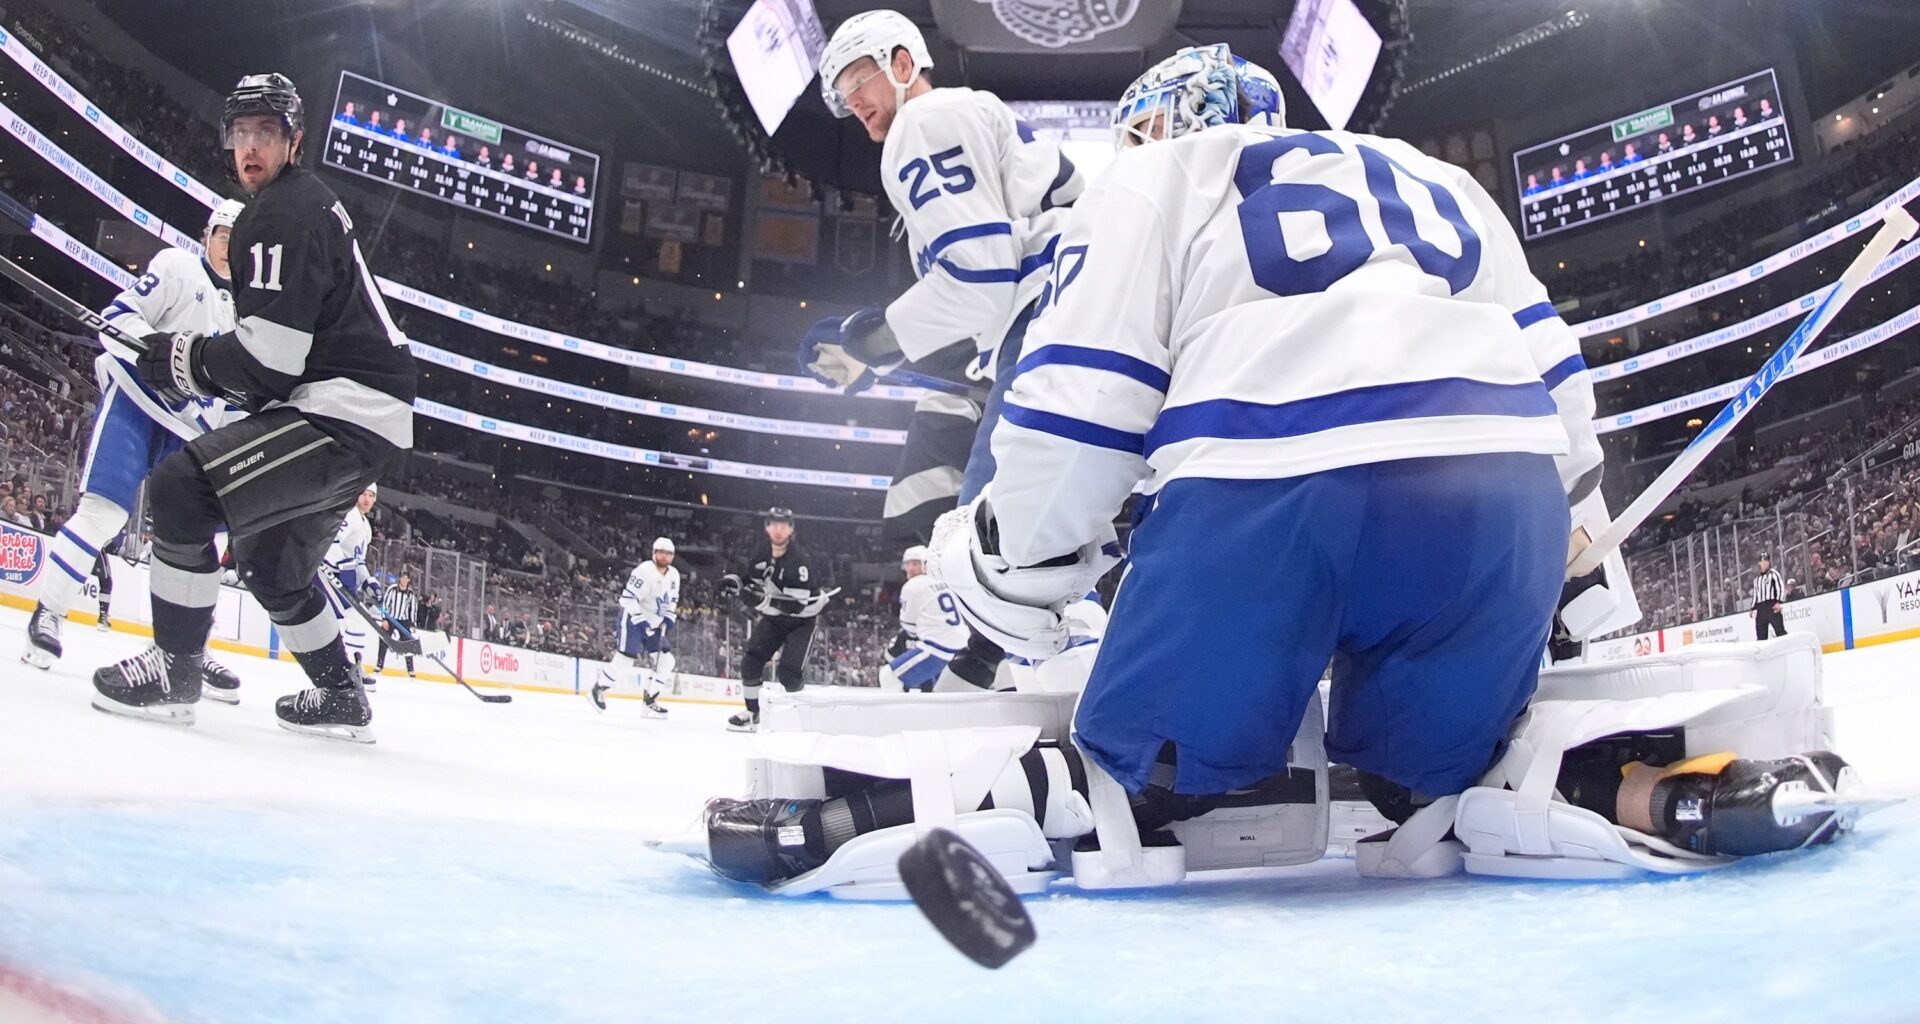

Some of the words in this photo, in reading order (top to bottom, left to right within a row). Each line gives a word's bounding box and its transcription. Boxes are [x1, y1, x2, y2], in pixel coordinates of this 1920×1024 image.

[33, 61, 48, 79] KEEP
[48, 74, 57, 87] ON
[57, 83, 77, 105] RISING
[122, 135, 136, 150] KEEP
[136, 145, 145, 158] ON
[10, 117, 28, 136] KEEP
[27, 130, 36, 146] ON
[37, 138, 76, 174] OVERCOMING
[75, 167, 95, 187] EVERY
[93, 181, 125, 210] CHALLENGE
[899, 145, 977, 211] 25
[133, 208, 148, 225] UCLA
[1234, 130, 1484, 298] 60
[175, 234, 190, 248] KEEP
[190, 242, 200, 255] ON
[1789, 246, 1804, 259] KEEP
[65, 238, 81, 256] KEEP
[80, 248, 90, 261] ON
[90, 253, 119, 283] BELIEVING
[250, 242, 283, 291] 11
[134, 272, 160, 297] 3
[410, 343, 427, 356] VERY
[1666, 346, 1683, 358] KEEP
[1823, 347, 1838, 360] KEEP
[1840, 342, 1849, 353] ON
[5, 572, 23, 581] SUBS
[798, 565, 808, 582] 9
[937, 592, 960, 627] 9
[1785, 606, 1811, 621] edicine
[1900, 601, 1920, 612] RESO
[494, 652, 519, 672] twilio
